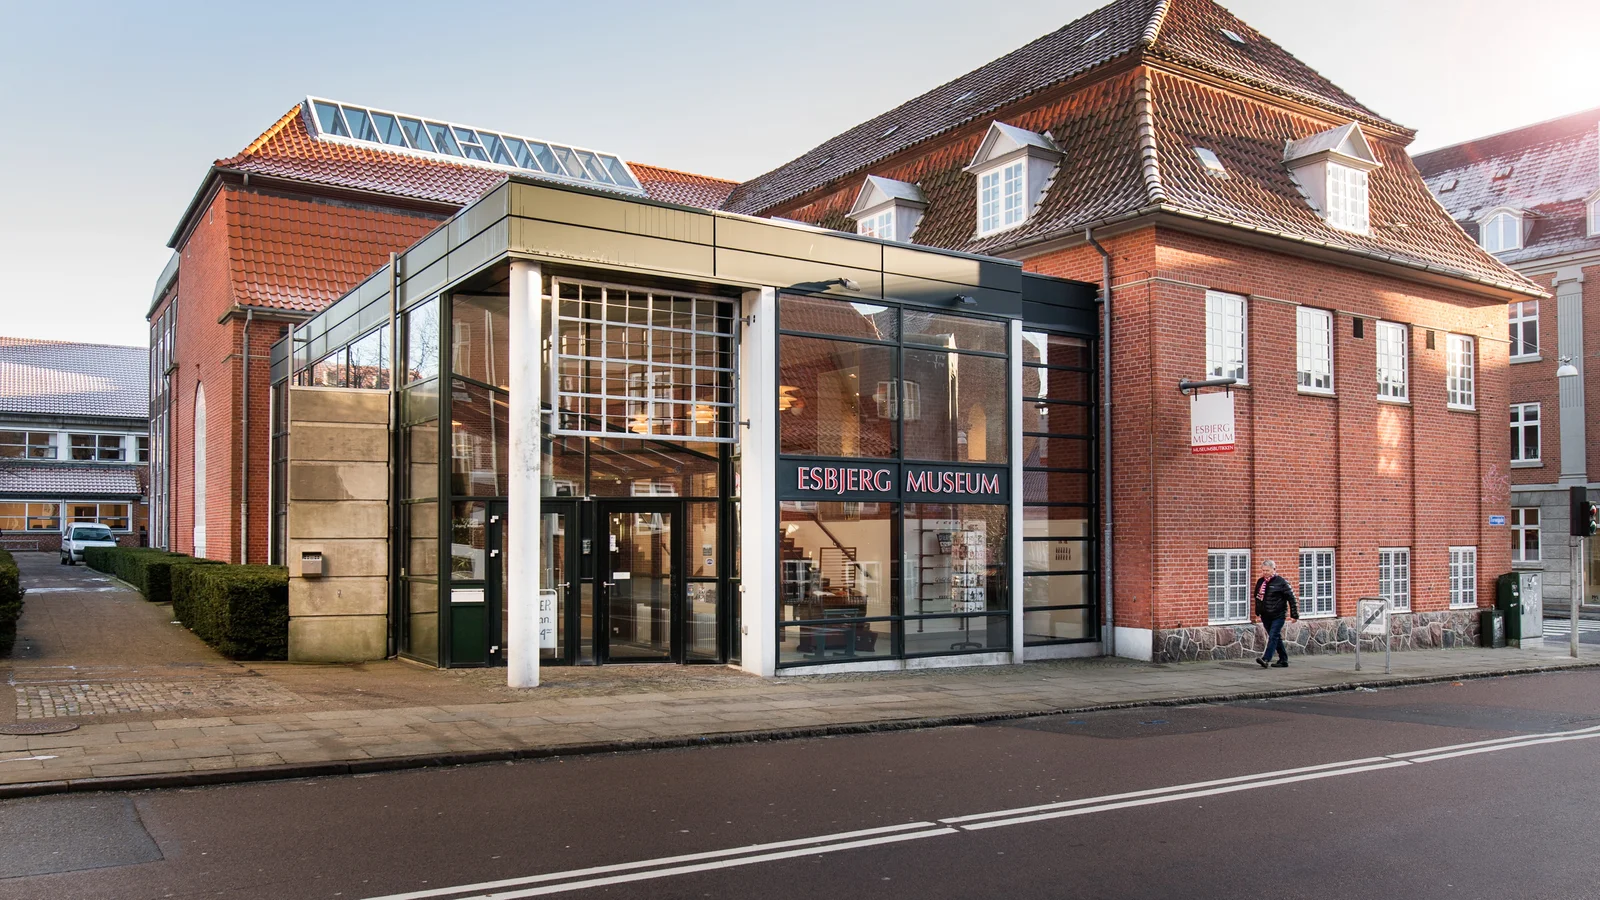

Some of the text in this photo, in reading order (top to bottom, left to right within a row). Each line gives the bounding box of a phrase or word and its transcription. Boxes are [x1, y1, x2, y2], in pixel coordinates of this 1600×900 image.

[1195, 423, 1230, 434] ESBJERG
[1193, 433, 1233, 443] MUSEUM
[797, 466, 1000, 495] ESBJERG MUSEUM
